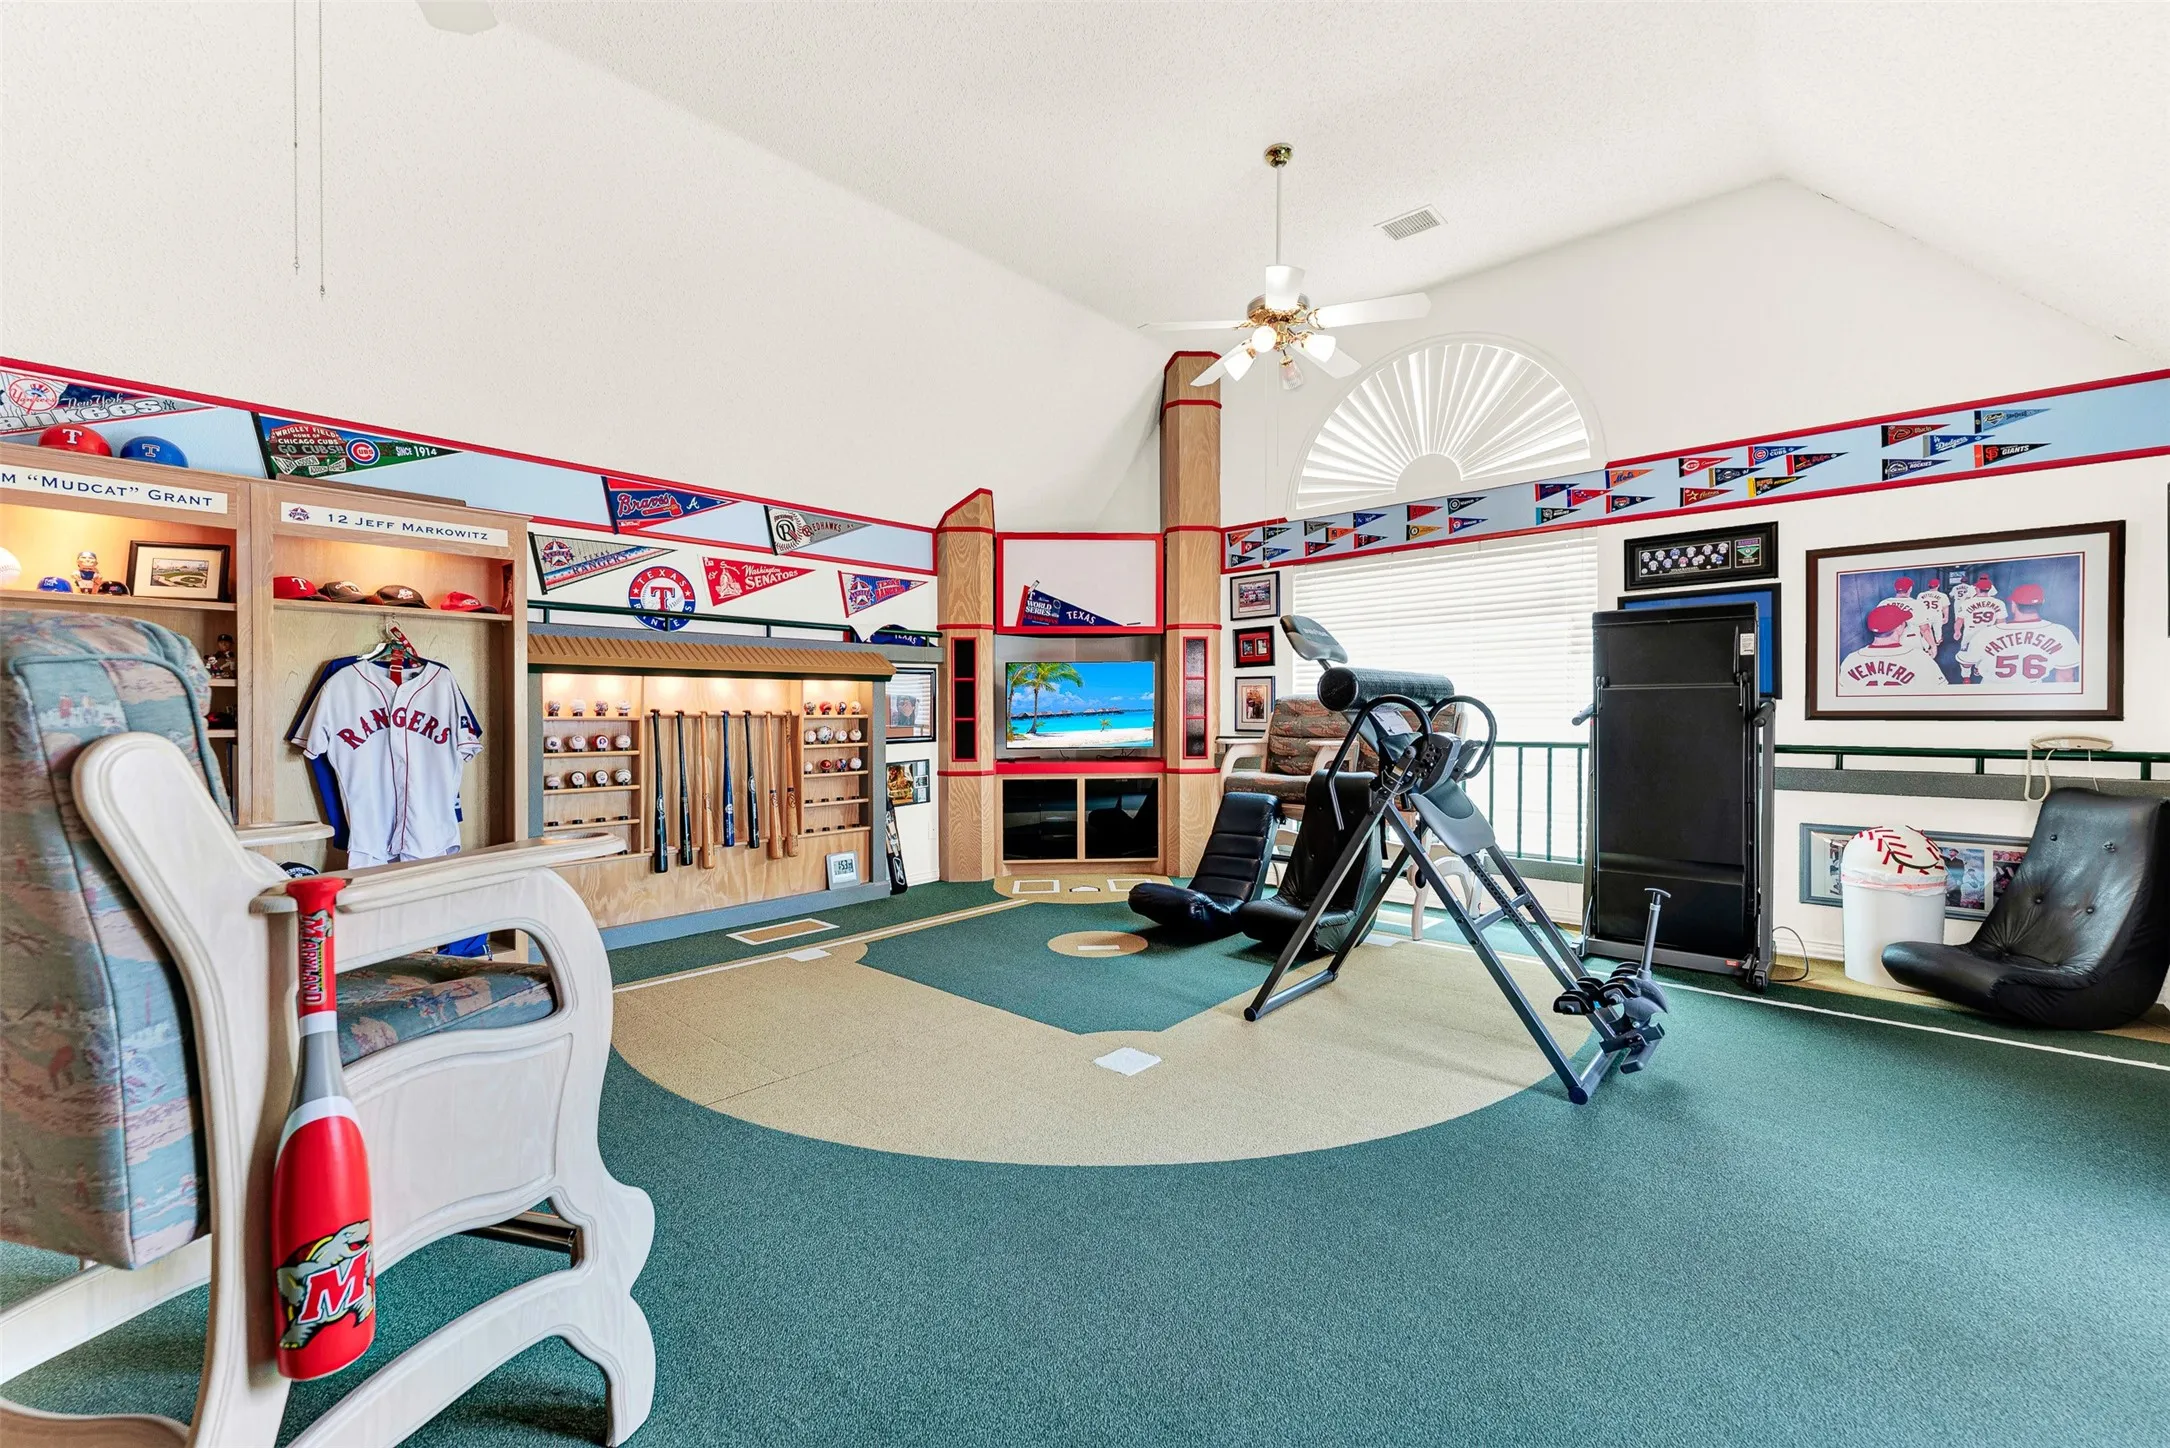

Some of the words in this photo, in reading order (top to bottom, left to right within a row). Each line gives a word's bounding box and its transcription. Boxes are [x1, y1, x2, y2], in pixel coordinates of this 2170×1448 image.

[62, 428, 82, 444] T
[275, 425, 309, 437] WRIGLEY
[312, 426, 336, 438] FIELD
[278, 444, 297, 454] GO
[1935, 436, 1968, 449] Dodgers
[2002, 445, 2029, 455] GIANTS
[142, 444, 160, 457] T
[395, 446, 412, 456] SINCE
[413, 446, 437, 457] 1914
[148, 490, 213, 506] GRANT
[617, 492, 669, 517] Braves
[686, 496, 700, 510] A
[328, 513, 348, 524] 12
[355, 517, 395, 530] JEFF
[402, 522, 488, 541] MARKOWITZ
[571, 551, 628, 575] RANGERS
[583, 550, 611, 561] TEXAS
[637, 569, 687, 587] TEXAS
[742, 564, 780, 577] Washington
[291, 577, 307, 591] T
[745, 570, 798, 590] SENATORS
[650, 586, 676, 611] T
[1027, 600, 1052, 610] WORLD
[1025, 606, 1052, 617] SERIES
[1066, 610, 1097, 625] TEXAS
[1972, 611, 1994, 624] 59
[1984, 631, 2063, 656] PATTERSON
[1848, 660, 1915, 684] VENAFRO
[1995, 654, 2048, 679] 56
[337, 706, 452, 750] RANGERS
[301, 914, 327, 1005] MARYLAND
[299, 1247, 370, 1324] M
